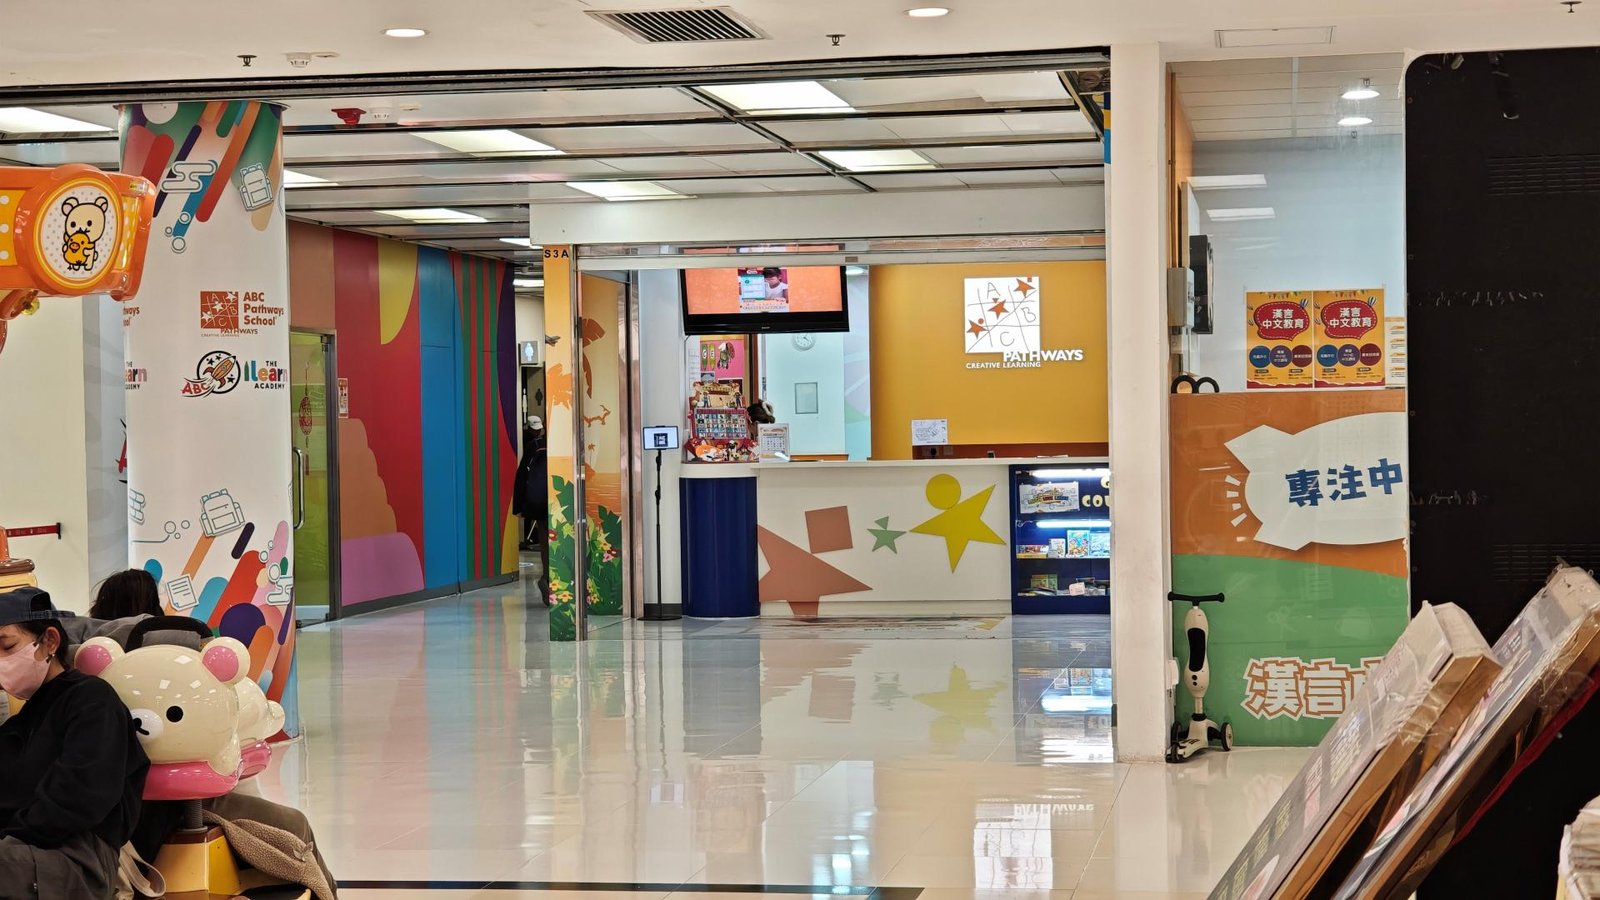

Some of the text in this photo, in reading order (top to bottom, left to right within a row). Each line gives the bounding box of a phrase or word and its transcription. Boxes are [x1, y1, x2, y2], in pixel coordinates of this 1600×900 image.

[243, 292, 265, 302] ABC
[987, 282, 1001, 299] A
[243, 303, 284, 316] Pathways
[1020, 306, 1037, 323] B
[1272, 308, 1294, 319] 漢言
[1339, 307, 1361, 317] 漢言
[243, 315, 276, 326] School
[1262, 318, 1304, 329] 中文教育
[1329, 317, 1372, 328] 中文教育
[1000, 331, 1015, 347] C
[1003, 349, 1084, 362] PATHWAYS
[181, 382, 209, 395] ABC
[1285, 458, 1403, 507] 專注中
